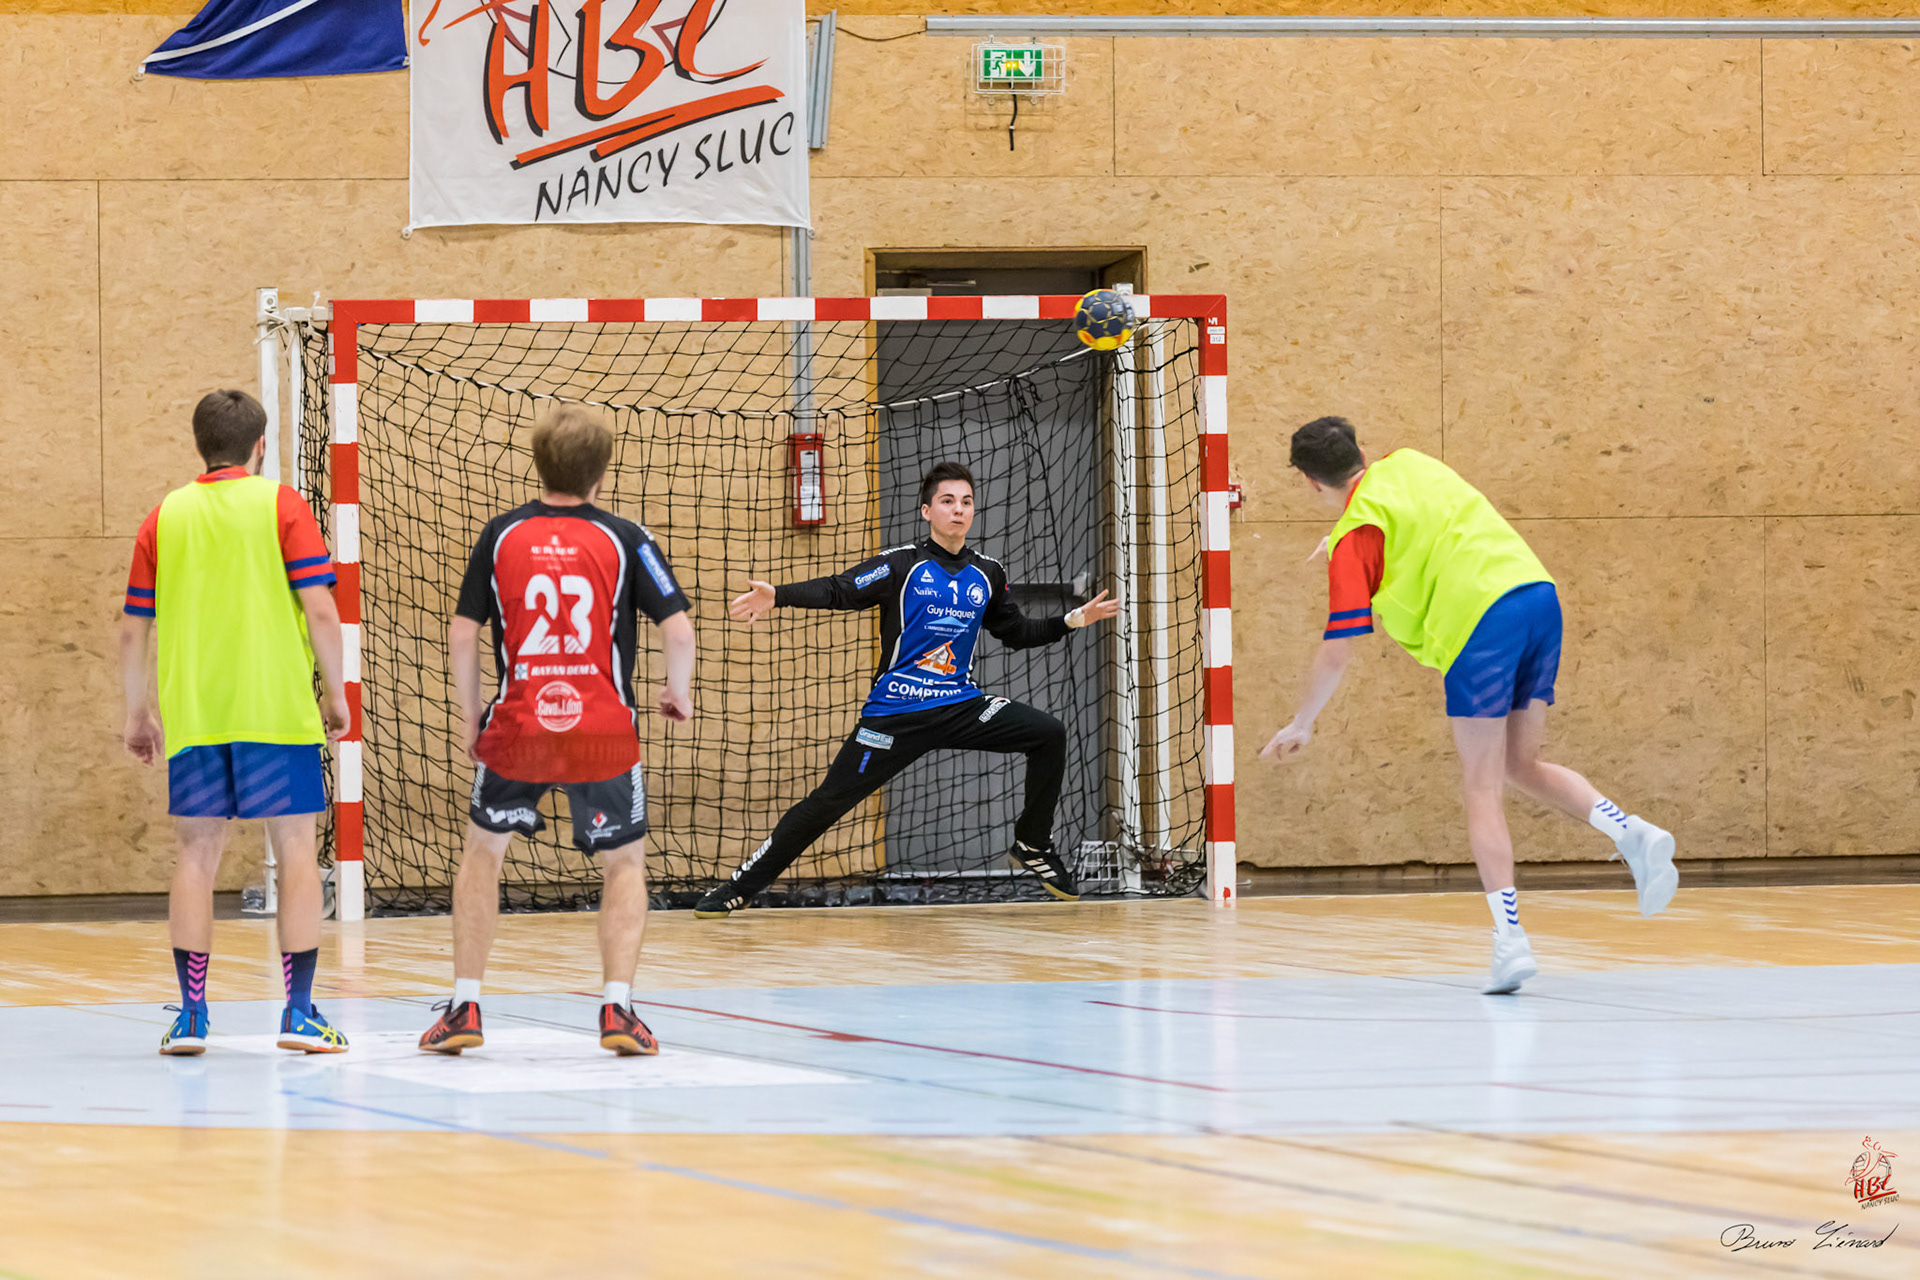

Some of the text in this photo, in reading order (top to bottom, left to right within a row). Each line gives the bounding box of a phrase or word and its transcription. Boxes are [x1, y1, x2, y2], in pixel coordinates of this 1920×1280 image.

[535, 111, 795, 222] NANCY SLUC
[947, 580, 958, 605] 1
[517, 573, 594, 656] 23
[926, 604, 976, 619] Guy Hoquet
[922, 677, 934, 685] LE
